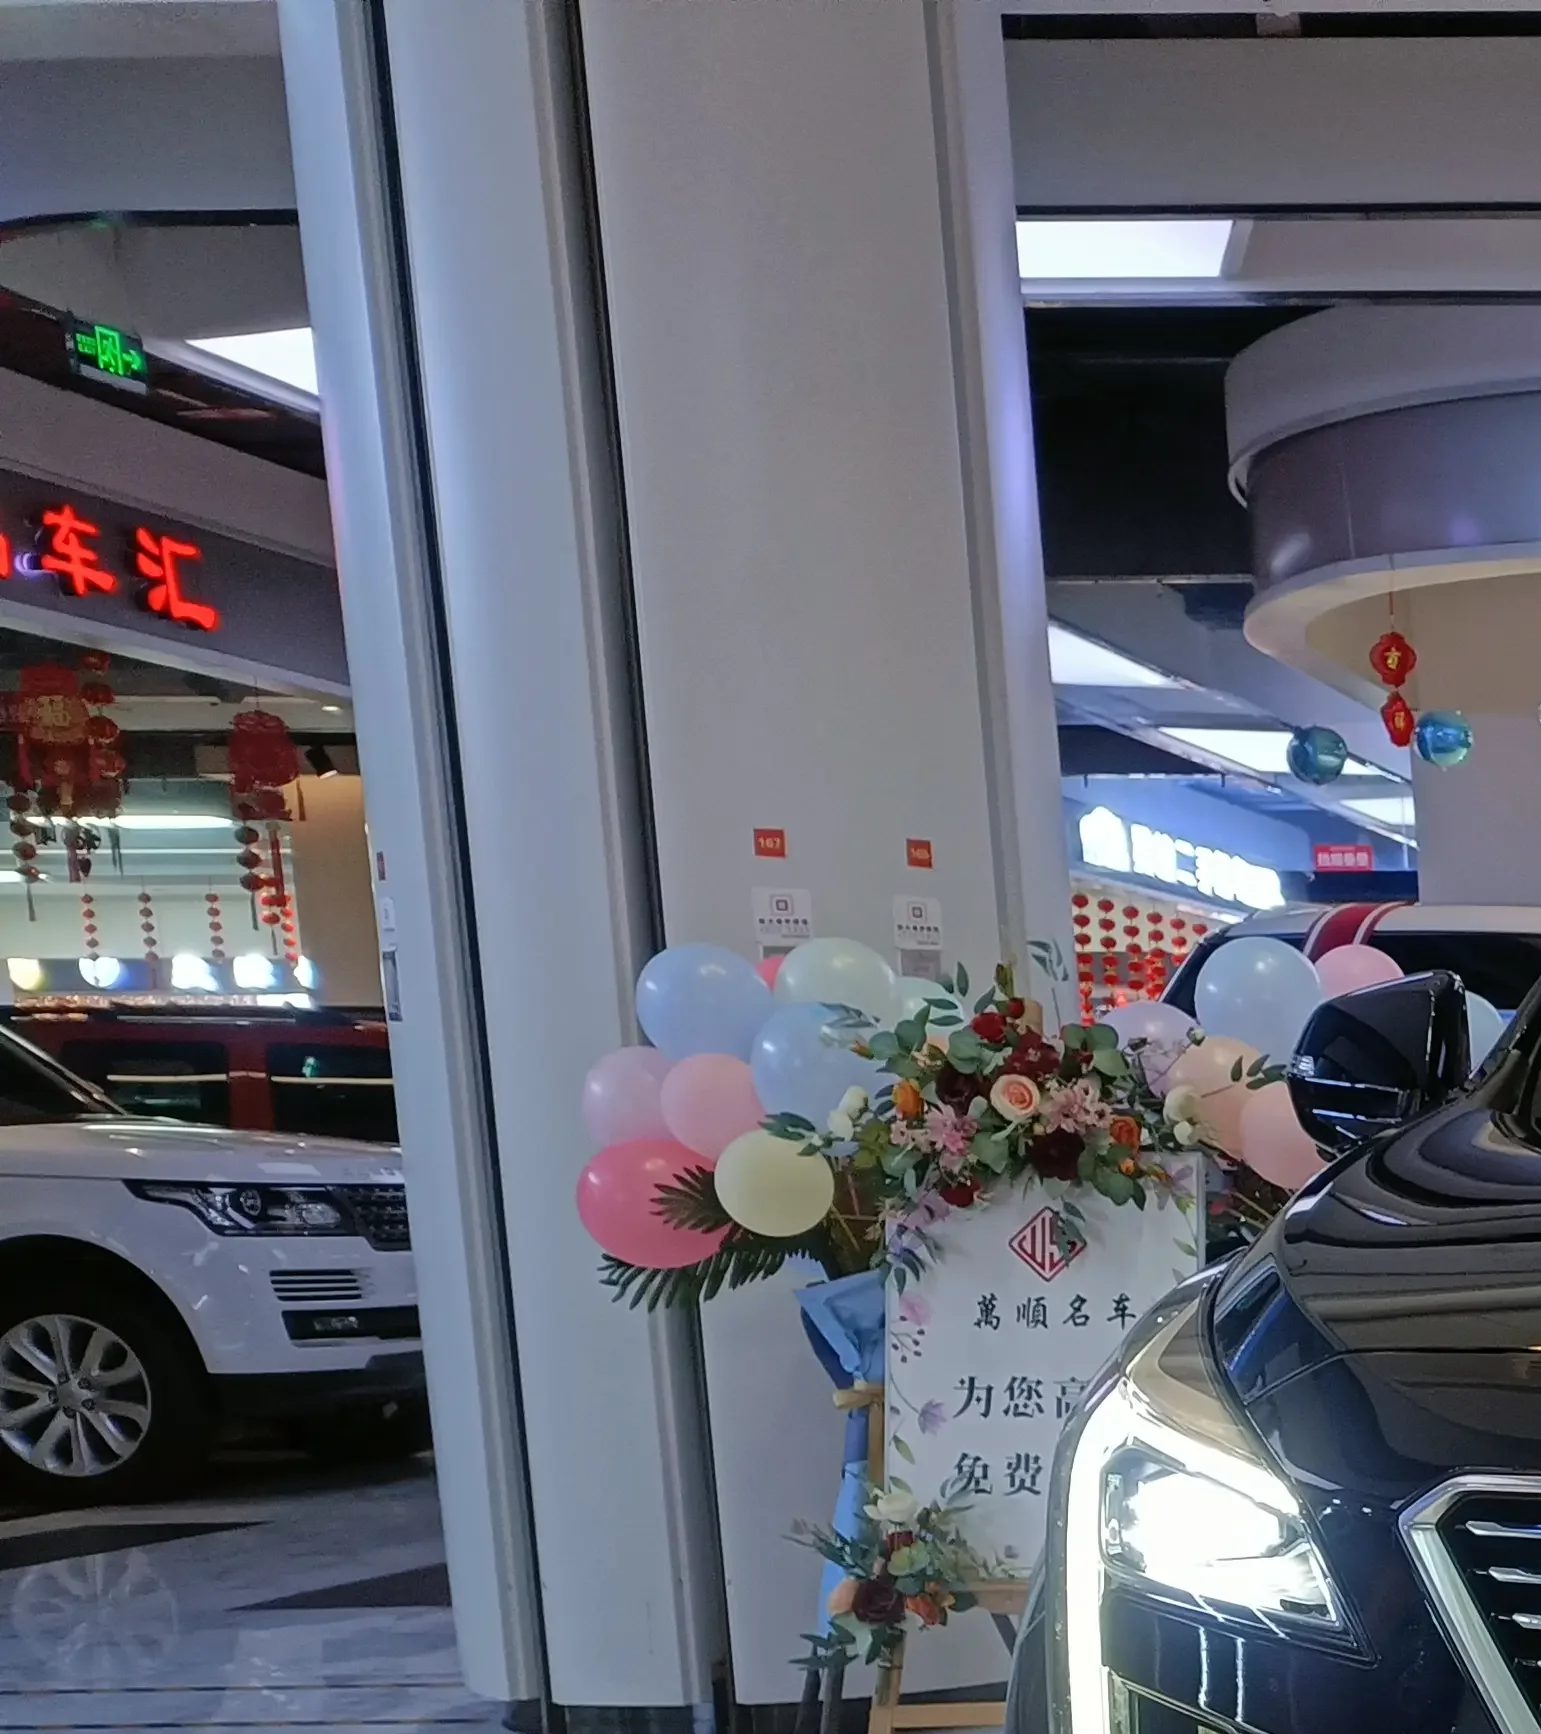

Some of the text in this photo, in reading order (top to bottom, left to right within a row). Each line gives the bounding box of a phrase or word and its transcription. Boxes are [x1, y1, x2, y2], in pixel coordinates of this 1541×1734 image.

[0, 503, 220, 632] 车汇
[973, 1292, 1137, 1332] 萬順名车
[950, 1451, 1043, 1497] 免费
